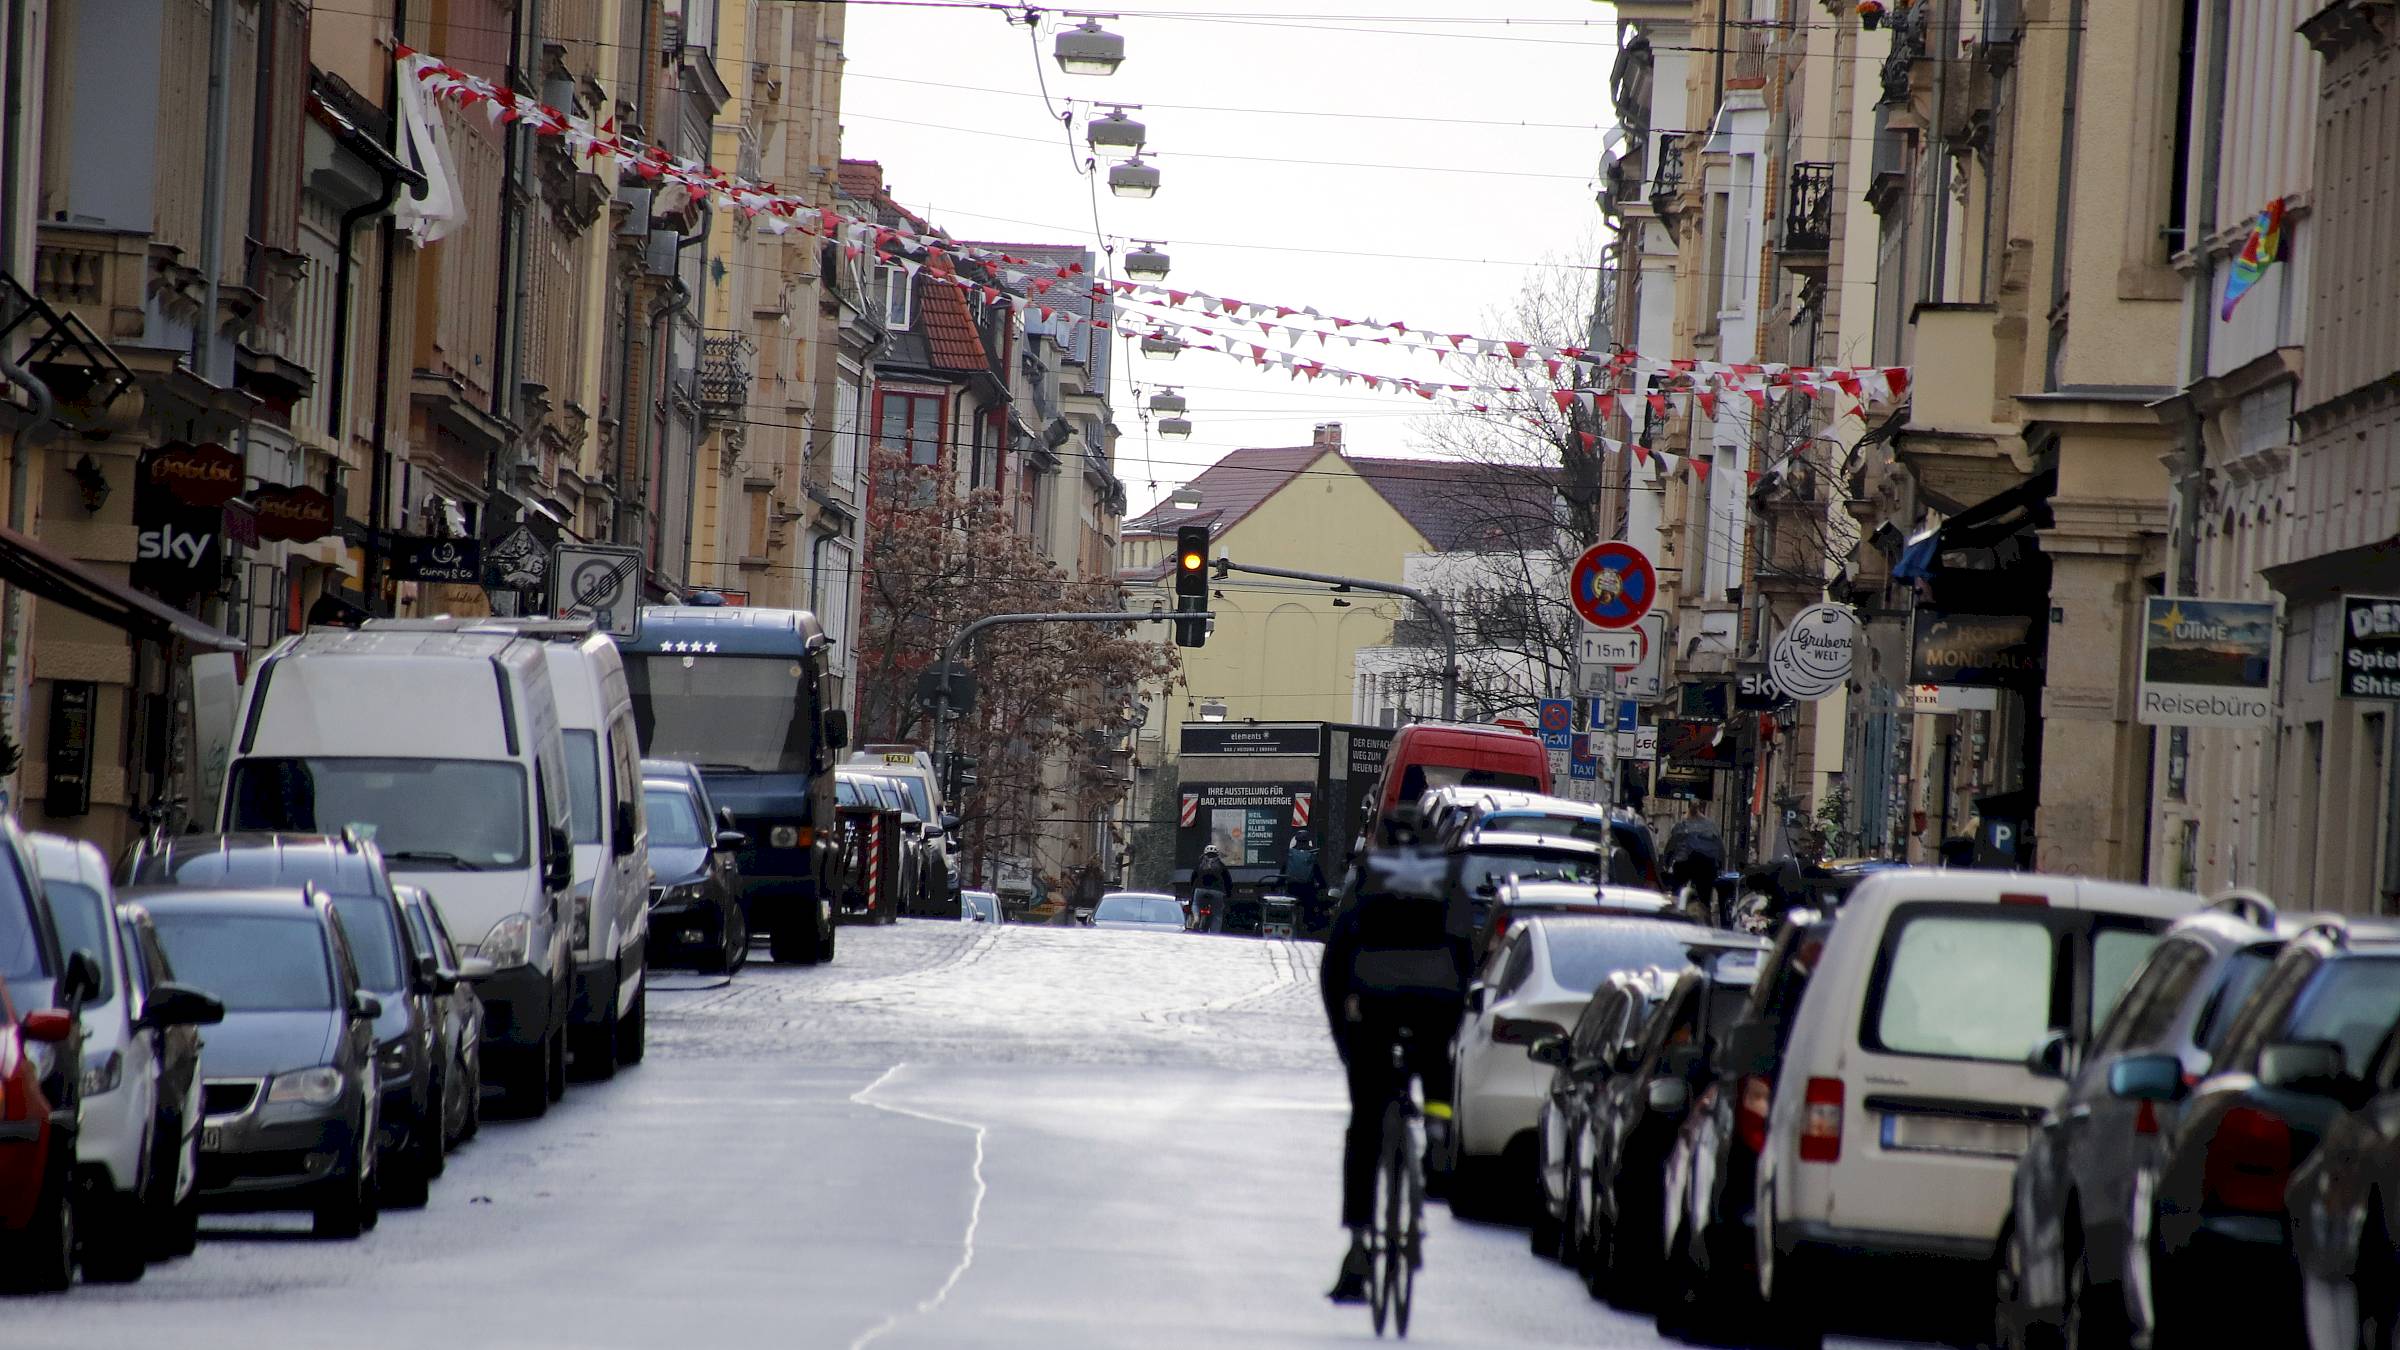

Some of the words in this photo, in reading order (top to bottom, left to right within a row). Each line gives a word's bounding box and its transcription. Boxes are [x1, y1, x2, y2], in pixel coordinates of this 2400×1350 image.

[139, 523, 211, 568] sky
[1598, 644, 1625, 657] 15m
[1814, 650, 1838, 661] WELT
[1741, 673, 1780, 701] sky
[2146, 692, 2266, 718] Reisebüro
[1230, 732, 1262, 741] elements
[1542, 733, 1568, 745] TAXI
[1353, 738, 1366, 748] DER
[888, 755, 909, 763] TAXI
[1352, 750, 1367, 761] WEG
[1367, 751, 1381, 761] ZUM
[1352, 763, 1373, 773] NEUEN
[1573, 764, 1595, 776] TAXI
[1207, 787, 1224, 796] IHRE
[1224, 787, 1269, 796] AUSSTELLUNG
[1270, 785, 1284, 796] FÜR
[1200, 797, 1217, 807] BAD,
[1218, 797, 1247, 806] HEIZUNG
[1247, 797, 1263, 806] UND
[1263, 797, 1292, 806] ENERGIE
[1995, 824, 2012, 849] P
